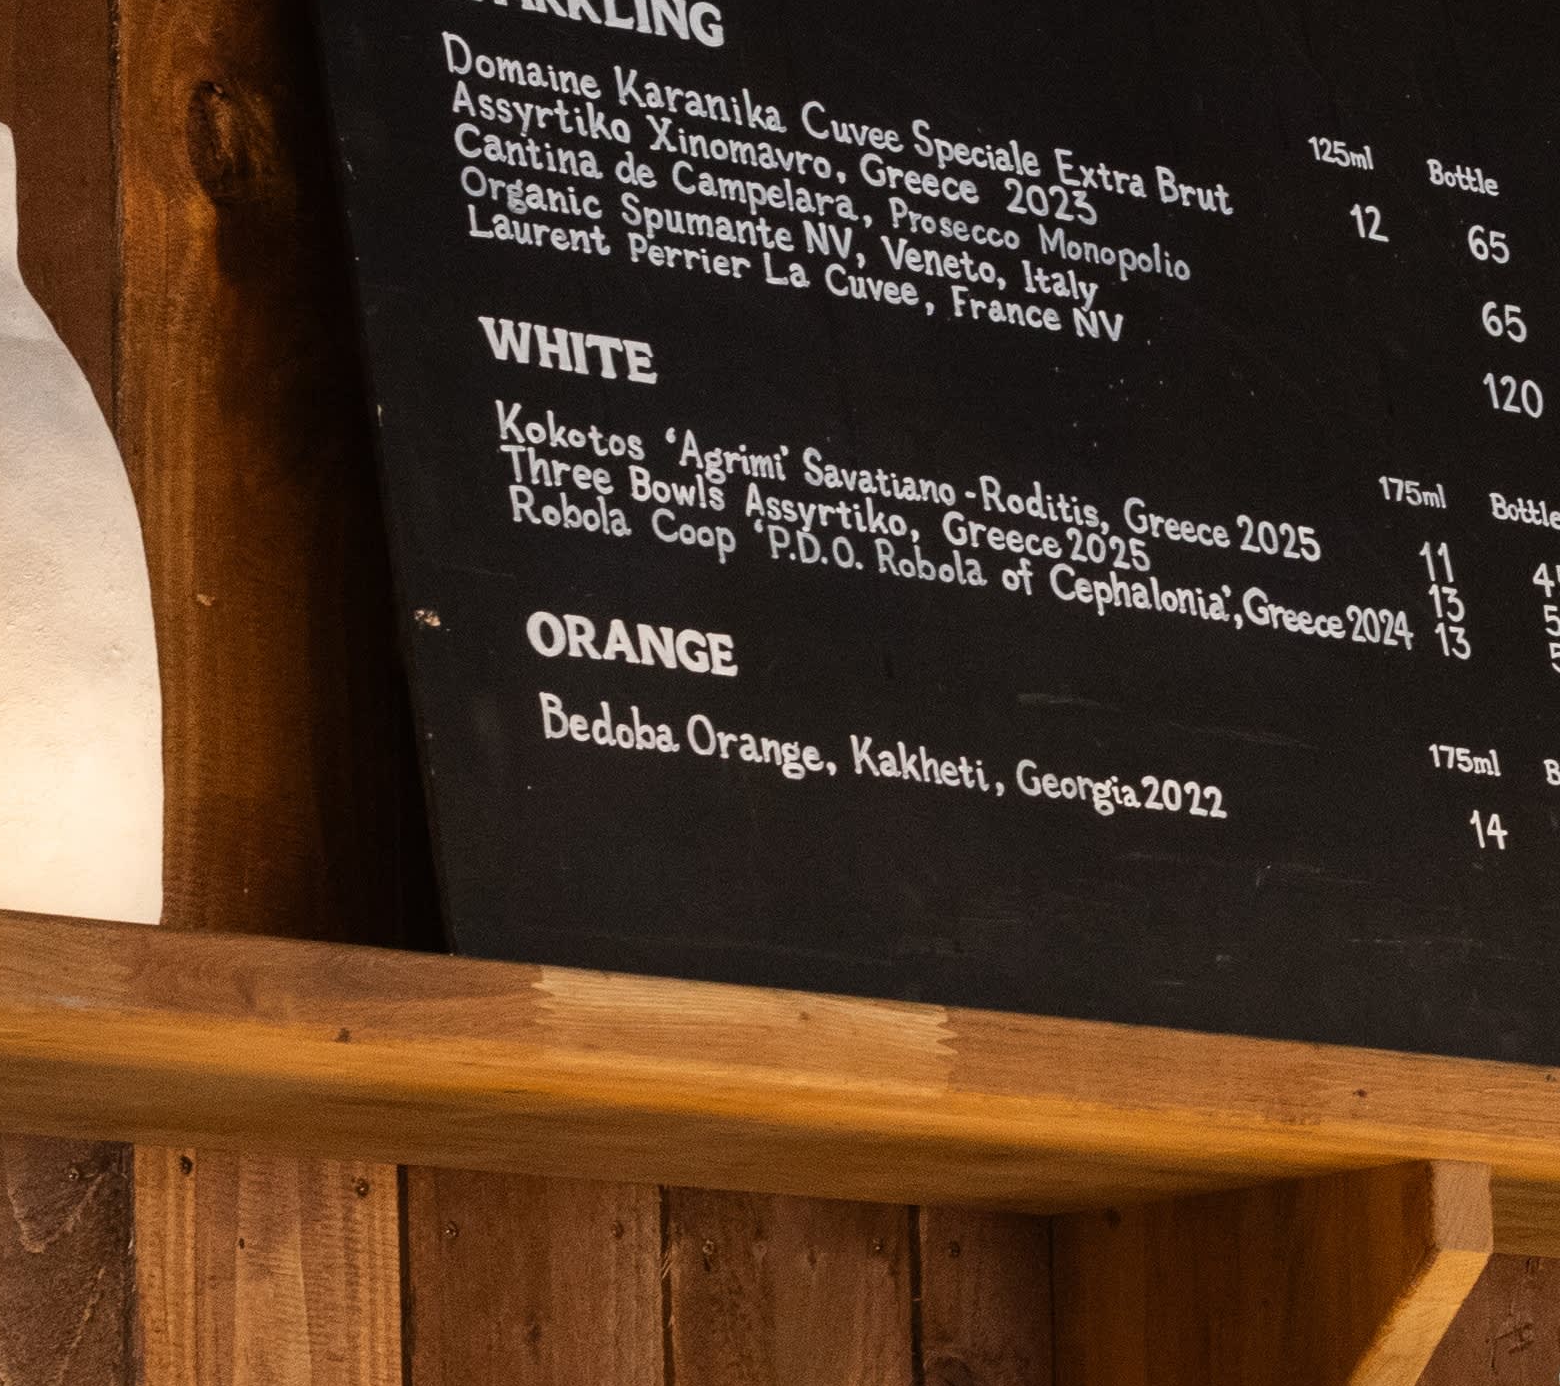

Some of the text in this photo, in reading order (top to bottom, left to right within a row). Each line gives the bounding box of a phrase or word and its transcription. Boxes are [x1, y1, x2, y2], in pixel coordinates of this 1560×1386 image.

[442, 31, 1233, 215] Domaine Karanika Cuvee Speciale Extra Brut
[453, 80, 1097, 225] Assyrtiko Xinomavro, Greece 2023
[1308, 137, 1374, 170] 125ml
[1427, 159, 1499, 196] Bottle
[1350, 204, 1389, 242] 12
[1468, 225, 1509, 263] 65
[1482, 301, 1527, 342] 65
[478, 316, 657, 384] WHITE
[1483, 373, 1543, 418] 120
[495, 400, 955, 506] Kokotos Savatiano
[500, 445, 725, 511] Three Bowls
[1379, 476, 1446, 508] 175ml
[1419, 541, 1454, 582] 11
[1429, 584, 1465, 622] 13
[527, 611, 738, 676] ORANGE
[1435, 623, 1471, 660] 13
[539, 692, 837, 780] Bedoba Orange,
[1470, 810, 1508, 849] 14
